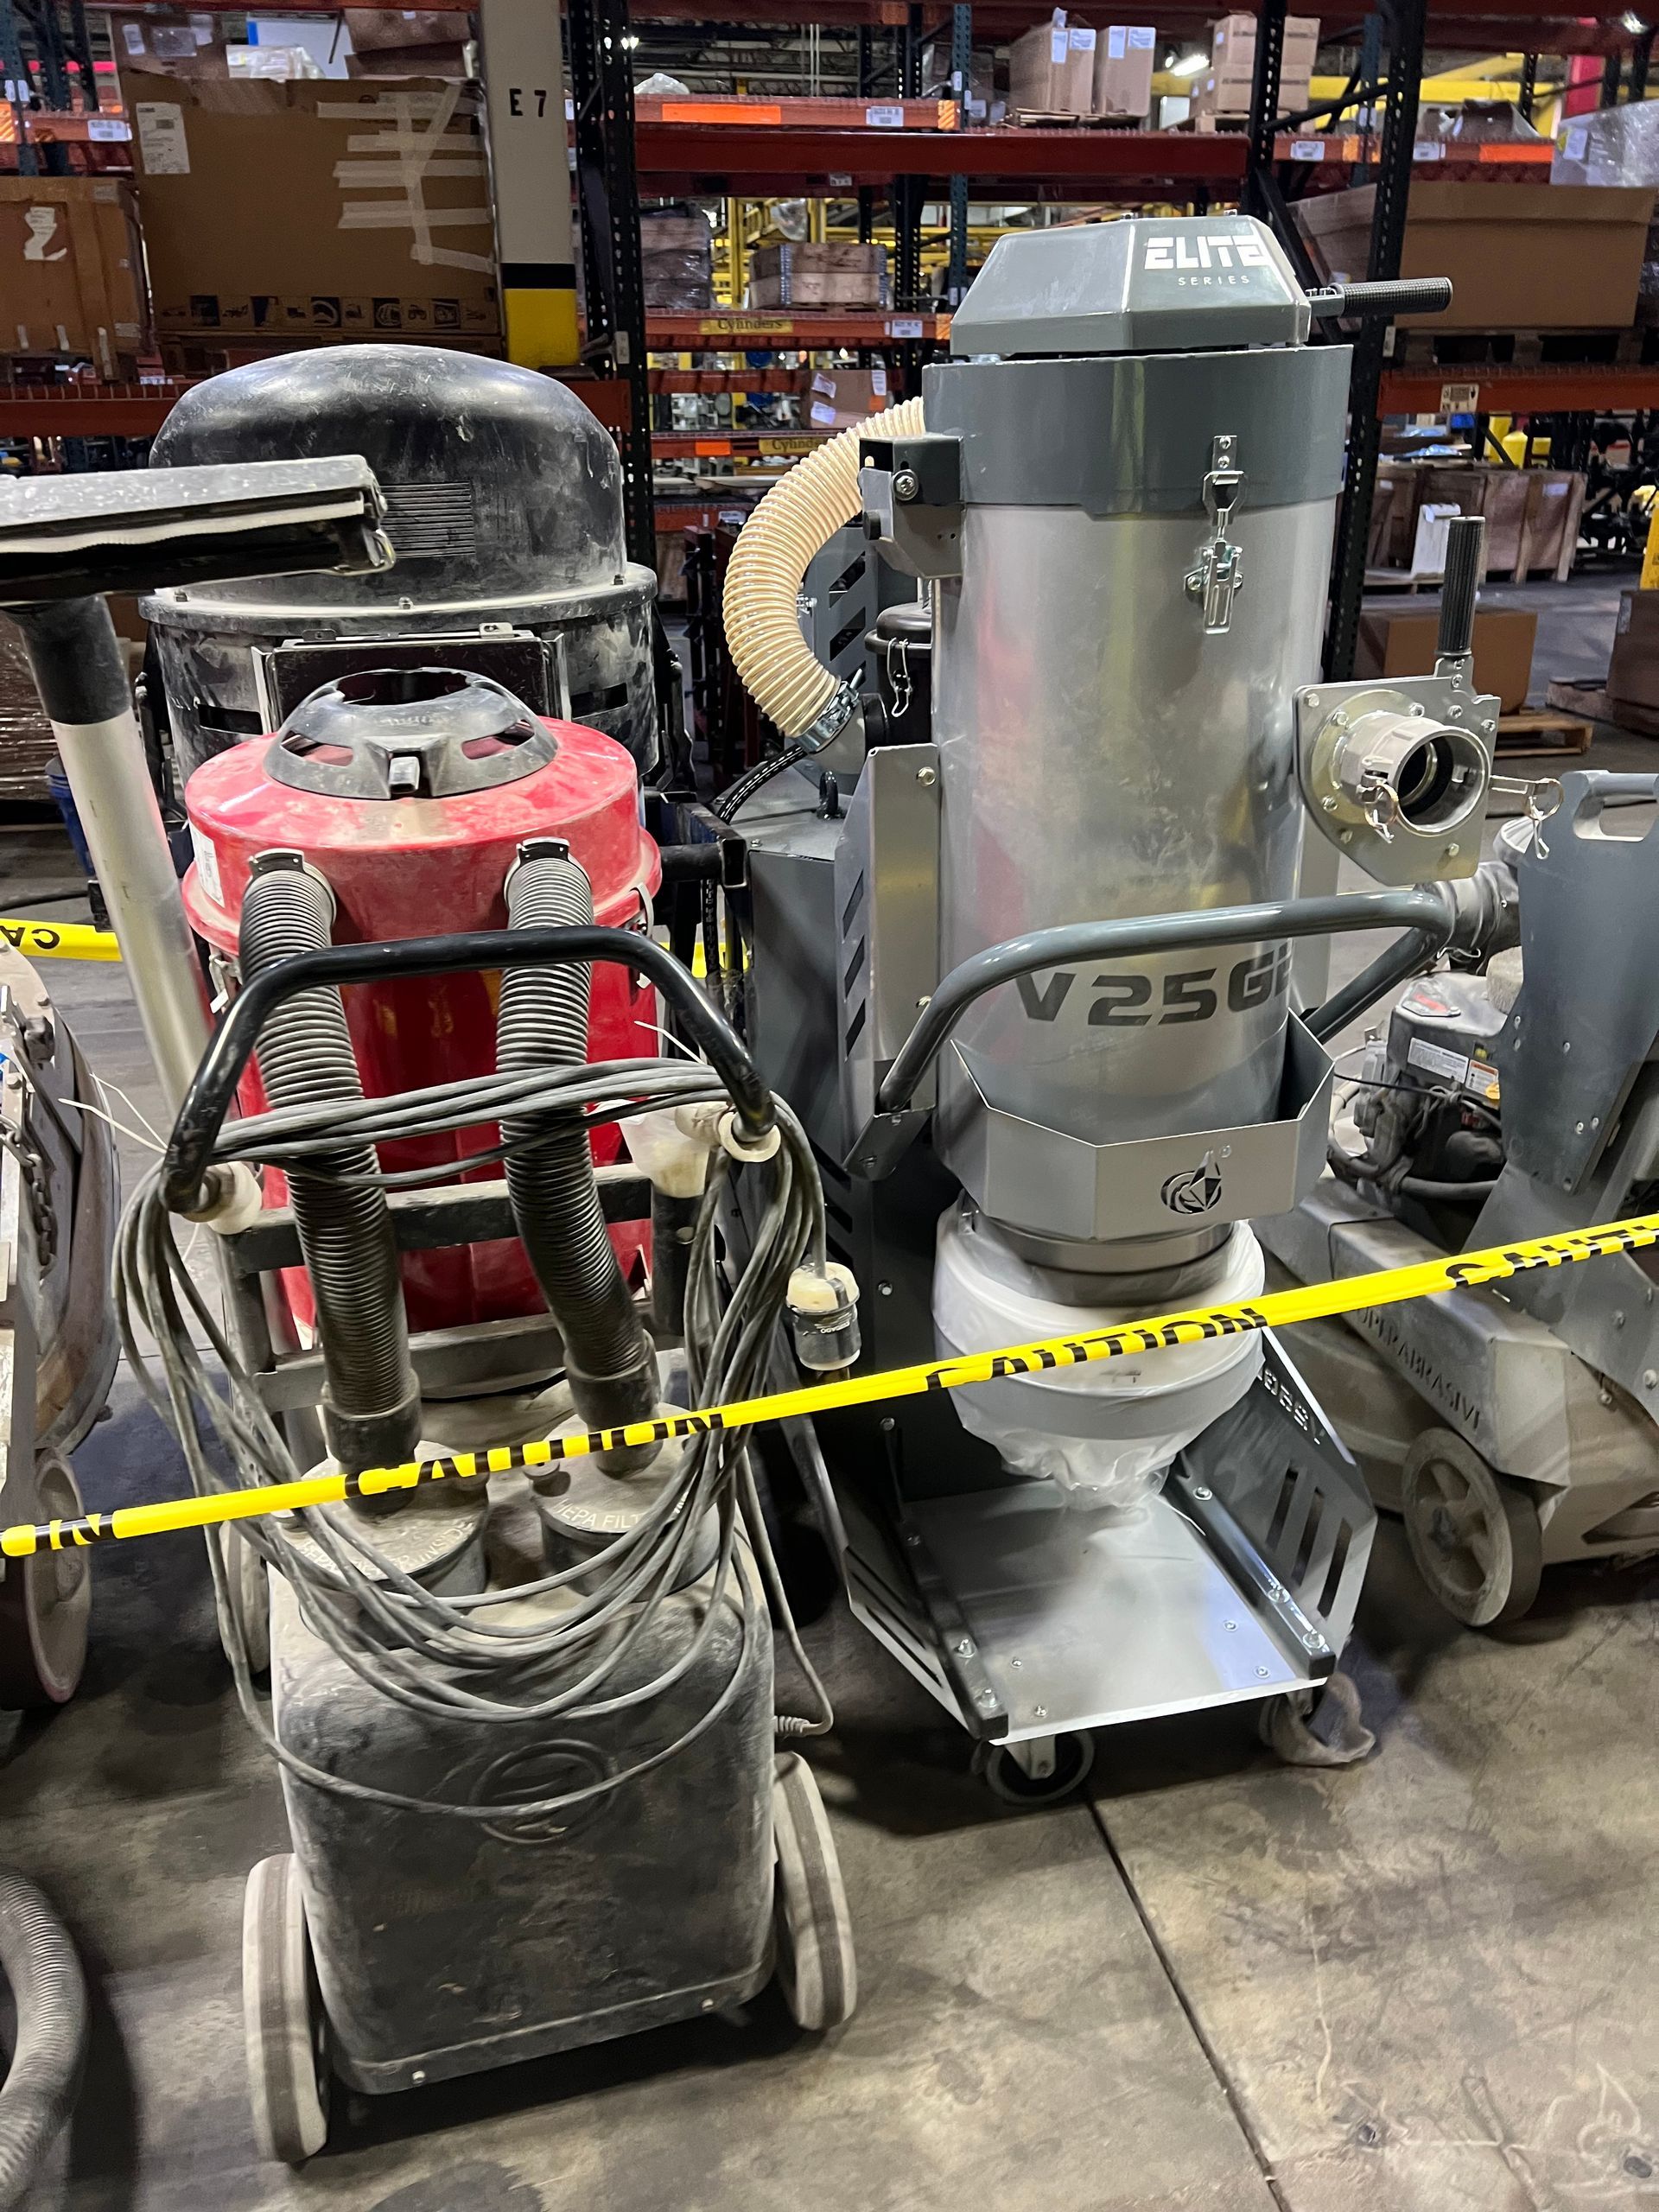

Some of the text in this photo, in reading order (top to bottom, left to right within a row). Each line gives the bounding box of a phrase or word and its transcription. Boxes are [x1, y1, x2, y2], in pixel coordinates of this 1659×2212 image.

[509, 88, 547, 118] E 7
[1144, 235, 1269, 270] ELITE
[1178, 275, 1250, 286] SERIES
[553, 1497, 597, 1529] HEPA
